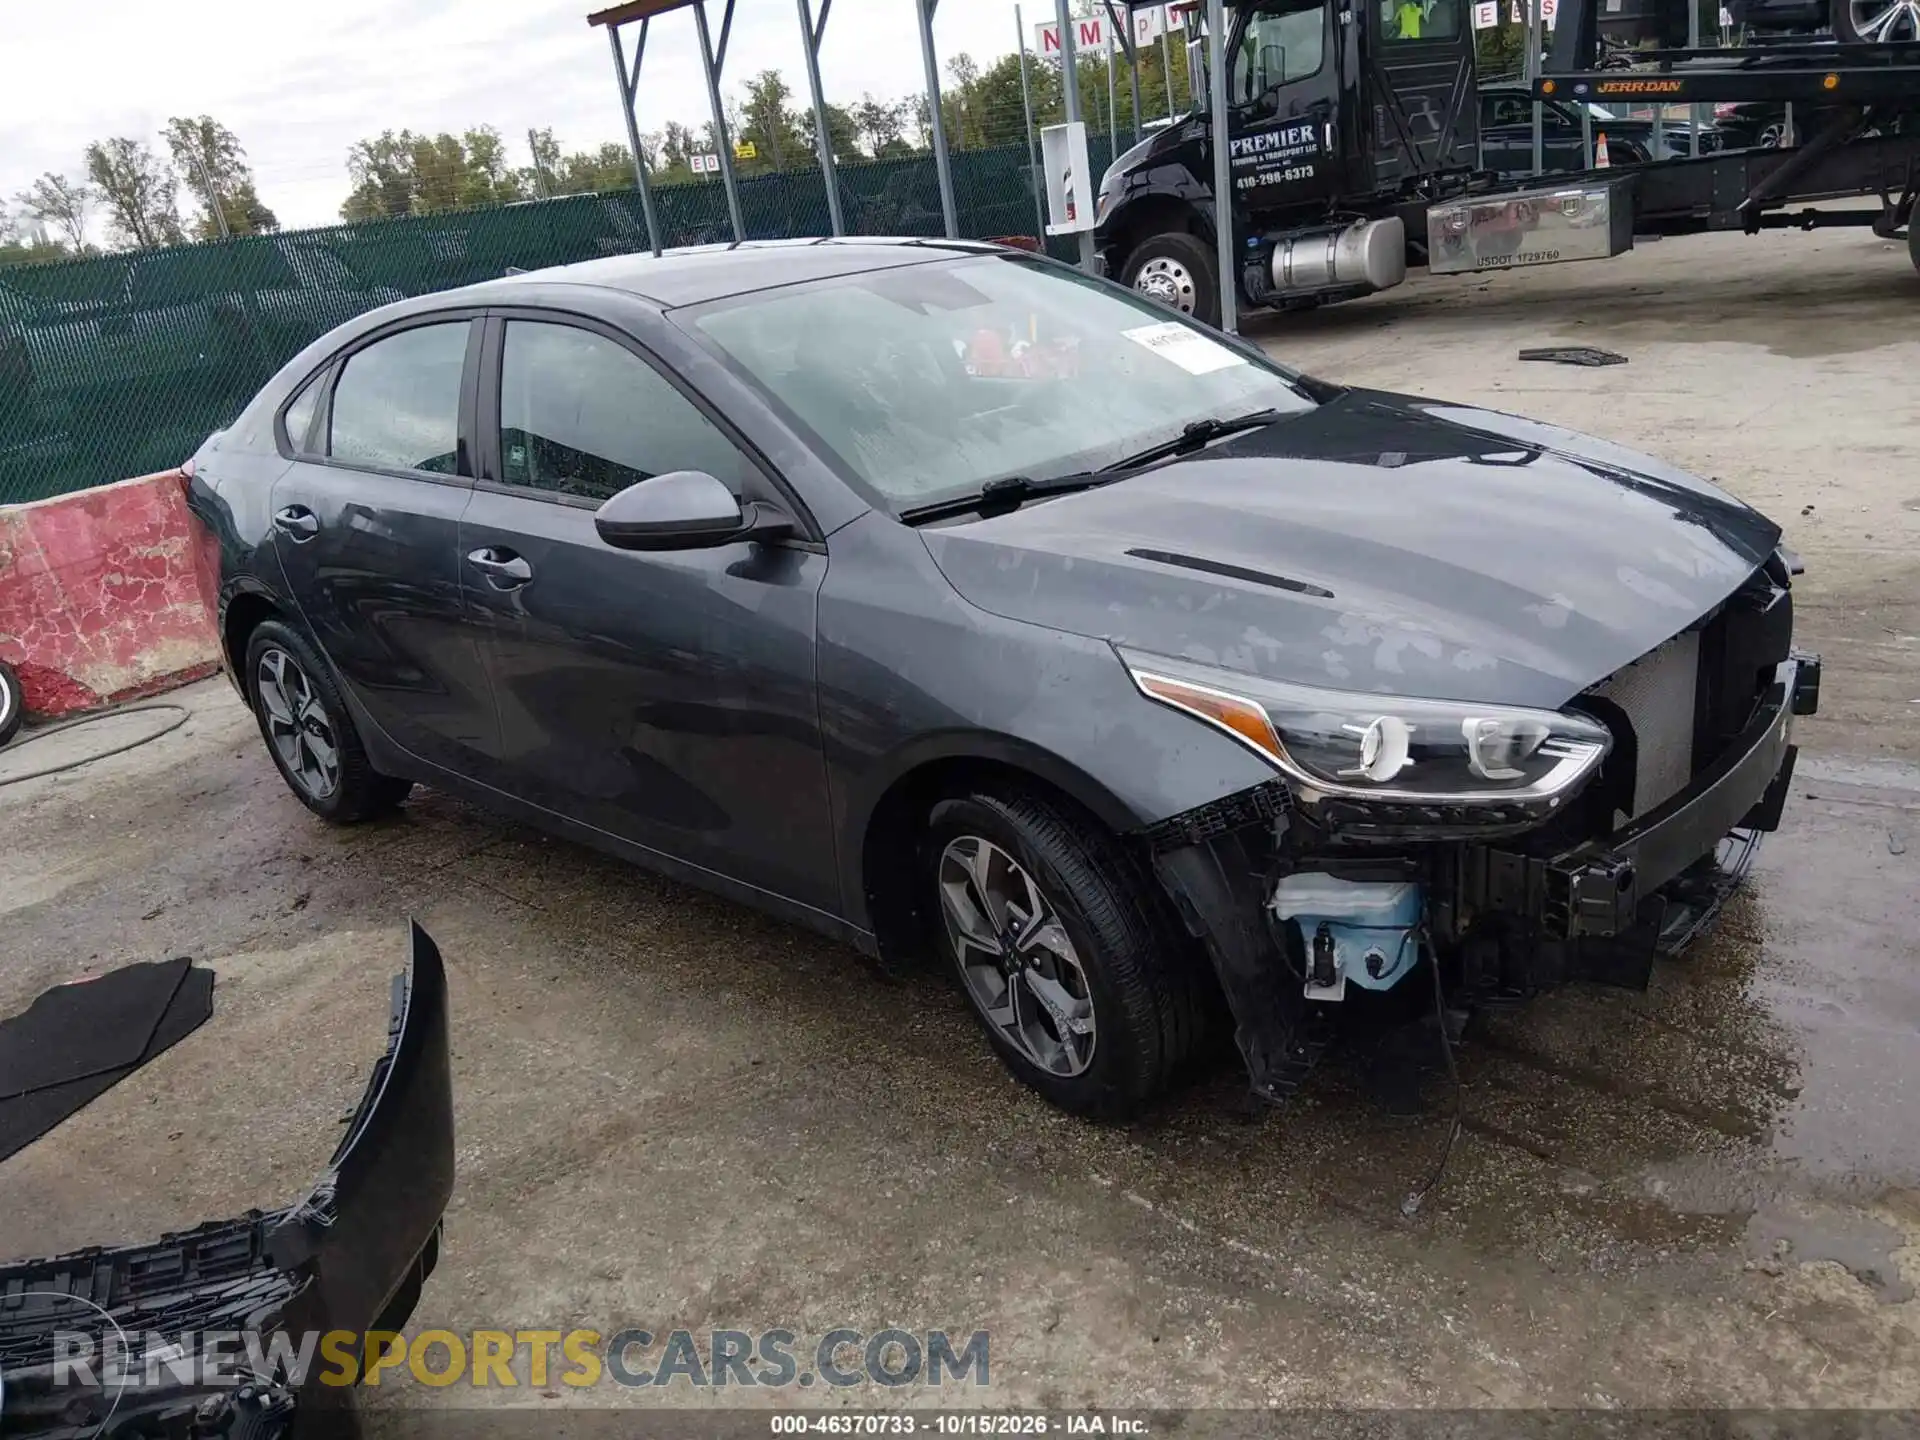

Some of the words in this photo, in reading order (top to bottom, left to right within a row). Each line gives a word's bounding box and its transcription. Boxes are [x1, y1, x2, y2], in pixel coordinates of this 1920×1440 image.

[1480, 7, 1493, 23] E
[1079, 21, 1101, 45] M
[1229, 125, 1315, 156] PREMIER
[1476, 254, 1513, 267] USDOT
[1517, 250, 1560, 263] 1729760
